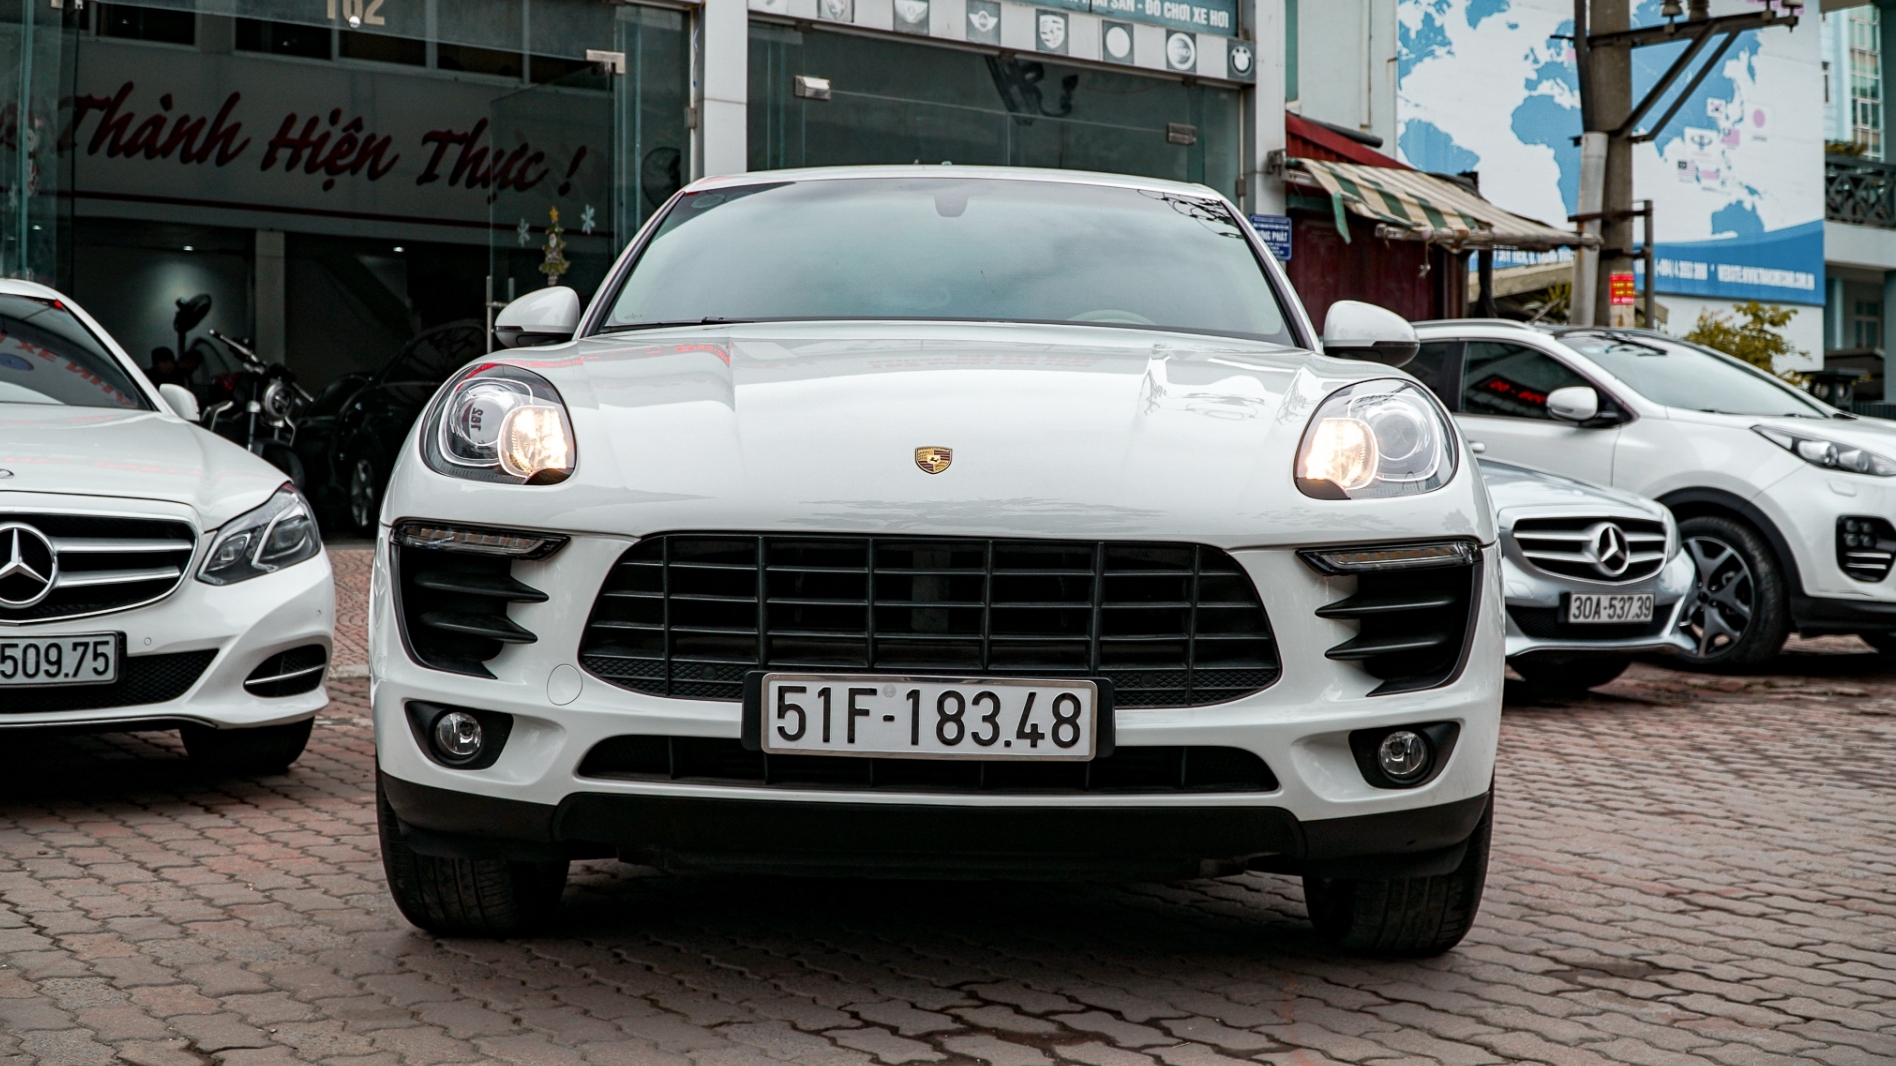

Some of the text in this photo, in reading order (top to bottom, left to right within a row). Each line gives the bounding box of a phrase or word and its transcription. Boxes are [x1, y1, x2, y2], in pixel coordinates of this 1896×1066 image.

[1163, 1, 1191, 22] CHƠI
[1192, 6, 1208, 25] XE
[1209, 9, 1230, 29] HƠI
[260, 107, 401, 191] Hiện
[416, 117, 550, 204] Thực
[1572, 595, 1652, 620] 30A-537.39
[0, 640, 110, 679] 509.75
[776, 685, 1082, 749] 51F-183.48
